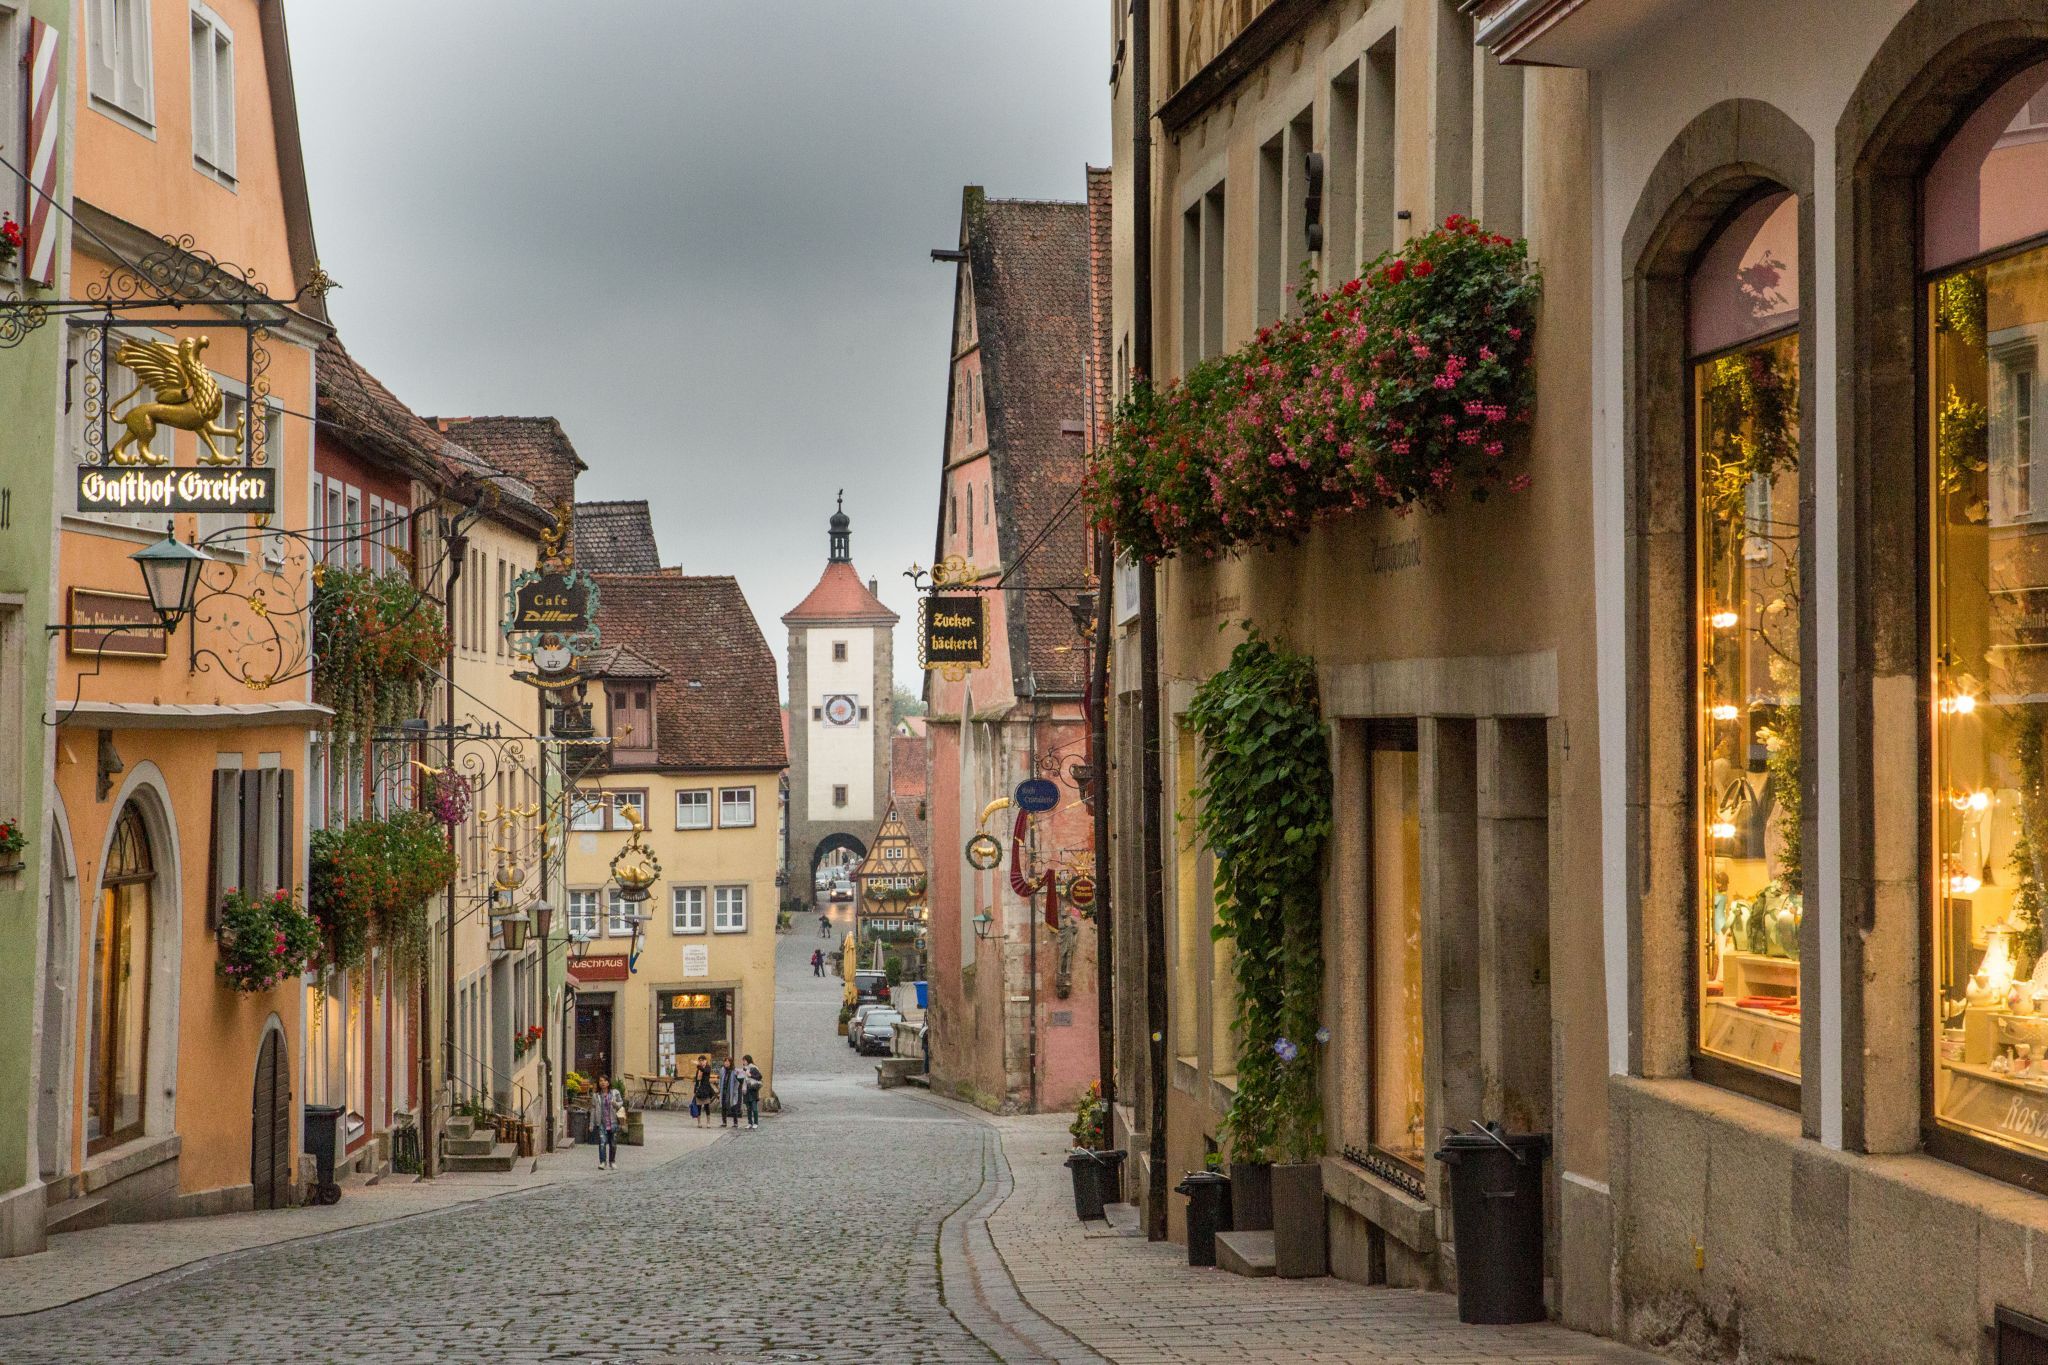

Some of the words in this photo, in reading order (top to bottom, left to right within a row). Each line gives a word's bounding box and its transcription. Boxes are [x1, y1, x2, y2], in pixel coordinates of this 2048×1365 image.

[178, 470, 266, 506] Greifen
[534, 594, 568, 606] Cafe
[523, 610, 579, 622] Diller
[933, 612, 976, 628] Zucker-
[931, 634, 978, 651] bäckerei
[2001, 1094, 2048, 1139] Rose
